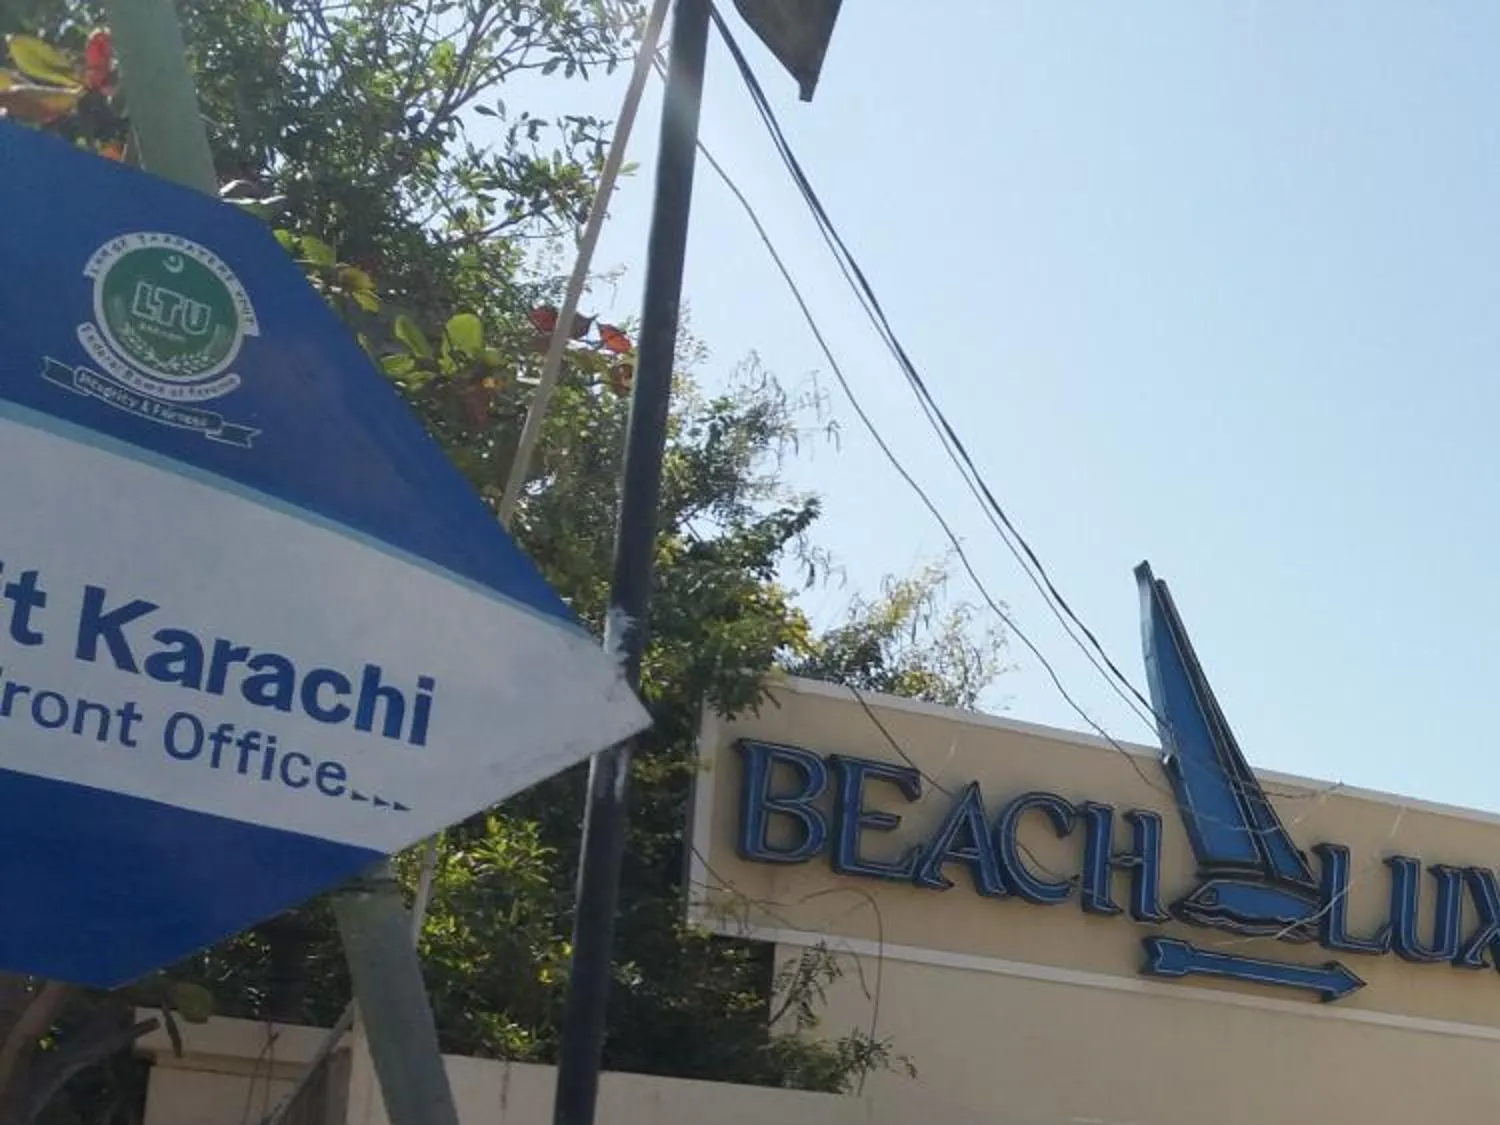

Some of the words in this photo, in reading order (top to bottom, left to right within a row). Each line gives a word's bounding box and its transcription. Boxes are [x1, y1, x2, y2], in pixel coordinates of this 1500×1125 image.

[131, 279, 212, 336] LTU
[0, 559, 47, 646] t
[75, 584, 437, 748] Karachi
[0, 668, 143, 748] ront
[163, 711, 347, 798] Office
[733, 737, 1173, 923] BEACH
